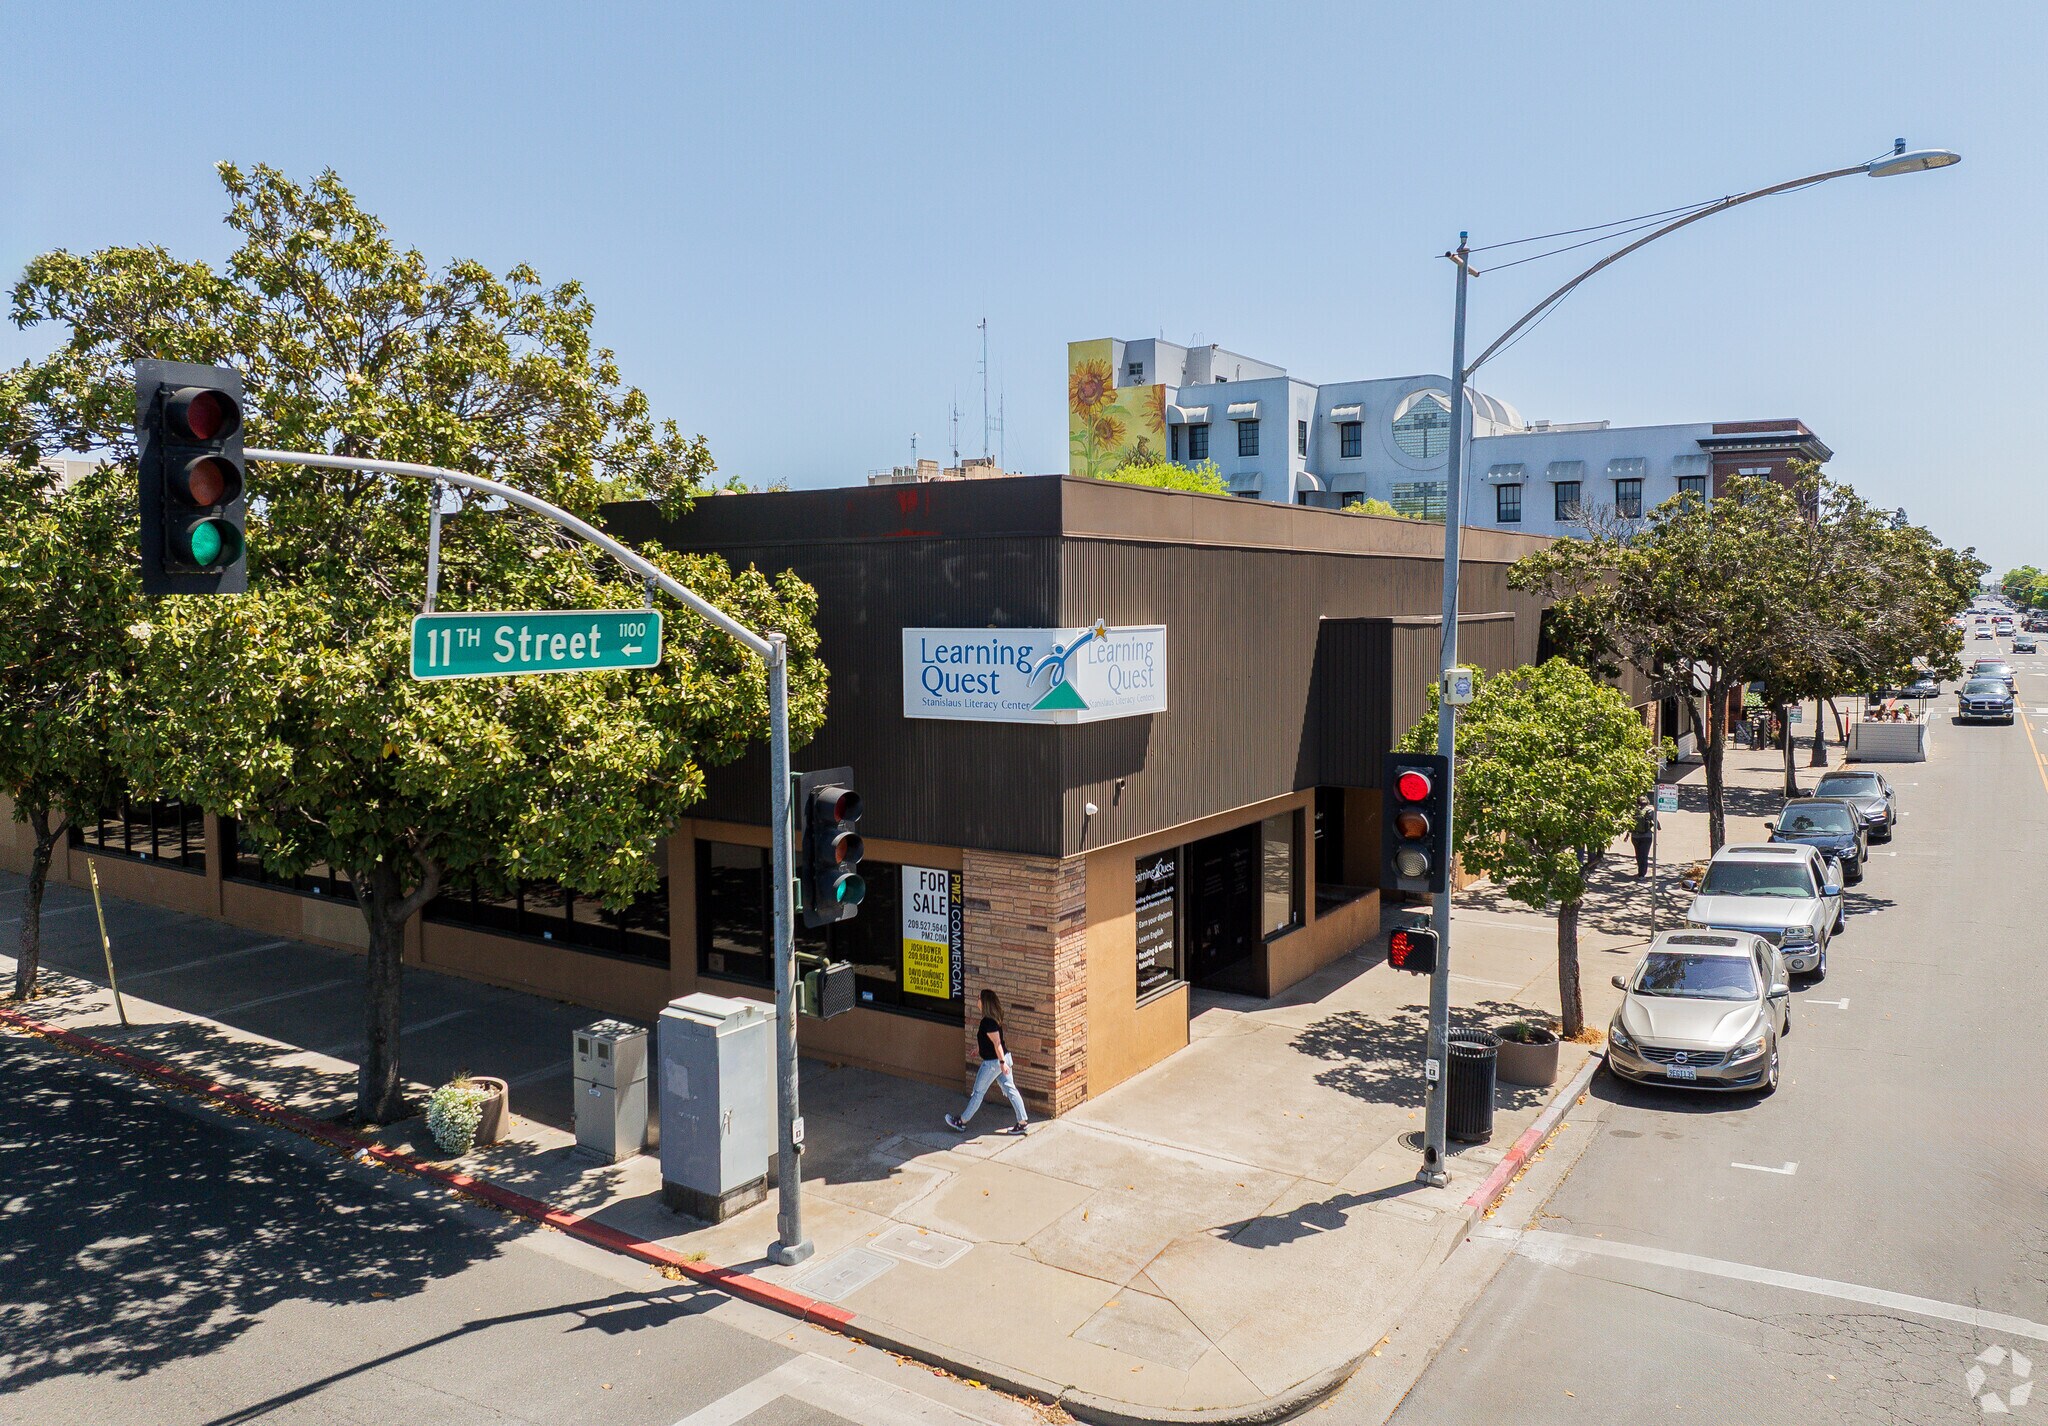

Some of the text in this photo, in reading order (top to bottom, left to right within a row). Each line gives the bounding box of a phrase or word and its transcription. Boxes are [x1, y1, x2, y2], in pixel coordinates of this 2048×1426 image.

[492, 624, 602, 663] Street
[618, 622, 646, 638] 1100
[921, 637, 1033, 674] Learning
[1088, 636, 1154, 668] Learning
[921, 665, 1000, 696] Quest
[1108, 664, 1154, 695] Quest
[922, 697, 962, 708] Stanislaus
[964, 698, 998, 711] Literacy
[1116, 696, 1135, 705] Literacy
[920, 871, 946, 893] FOR
[1135, 868, 1156, 884] earning
[913, 893, 947, 916] SALE
[921, 931, 947, 943] PMZ.COM
[951, 874, 962, 998] PMZ COMMERCIAL
